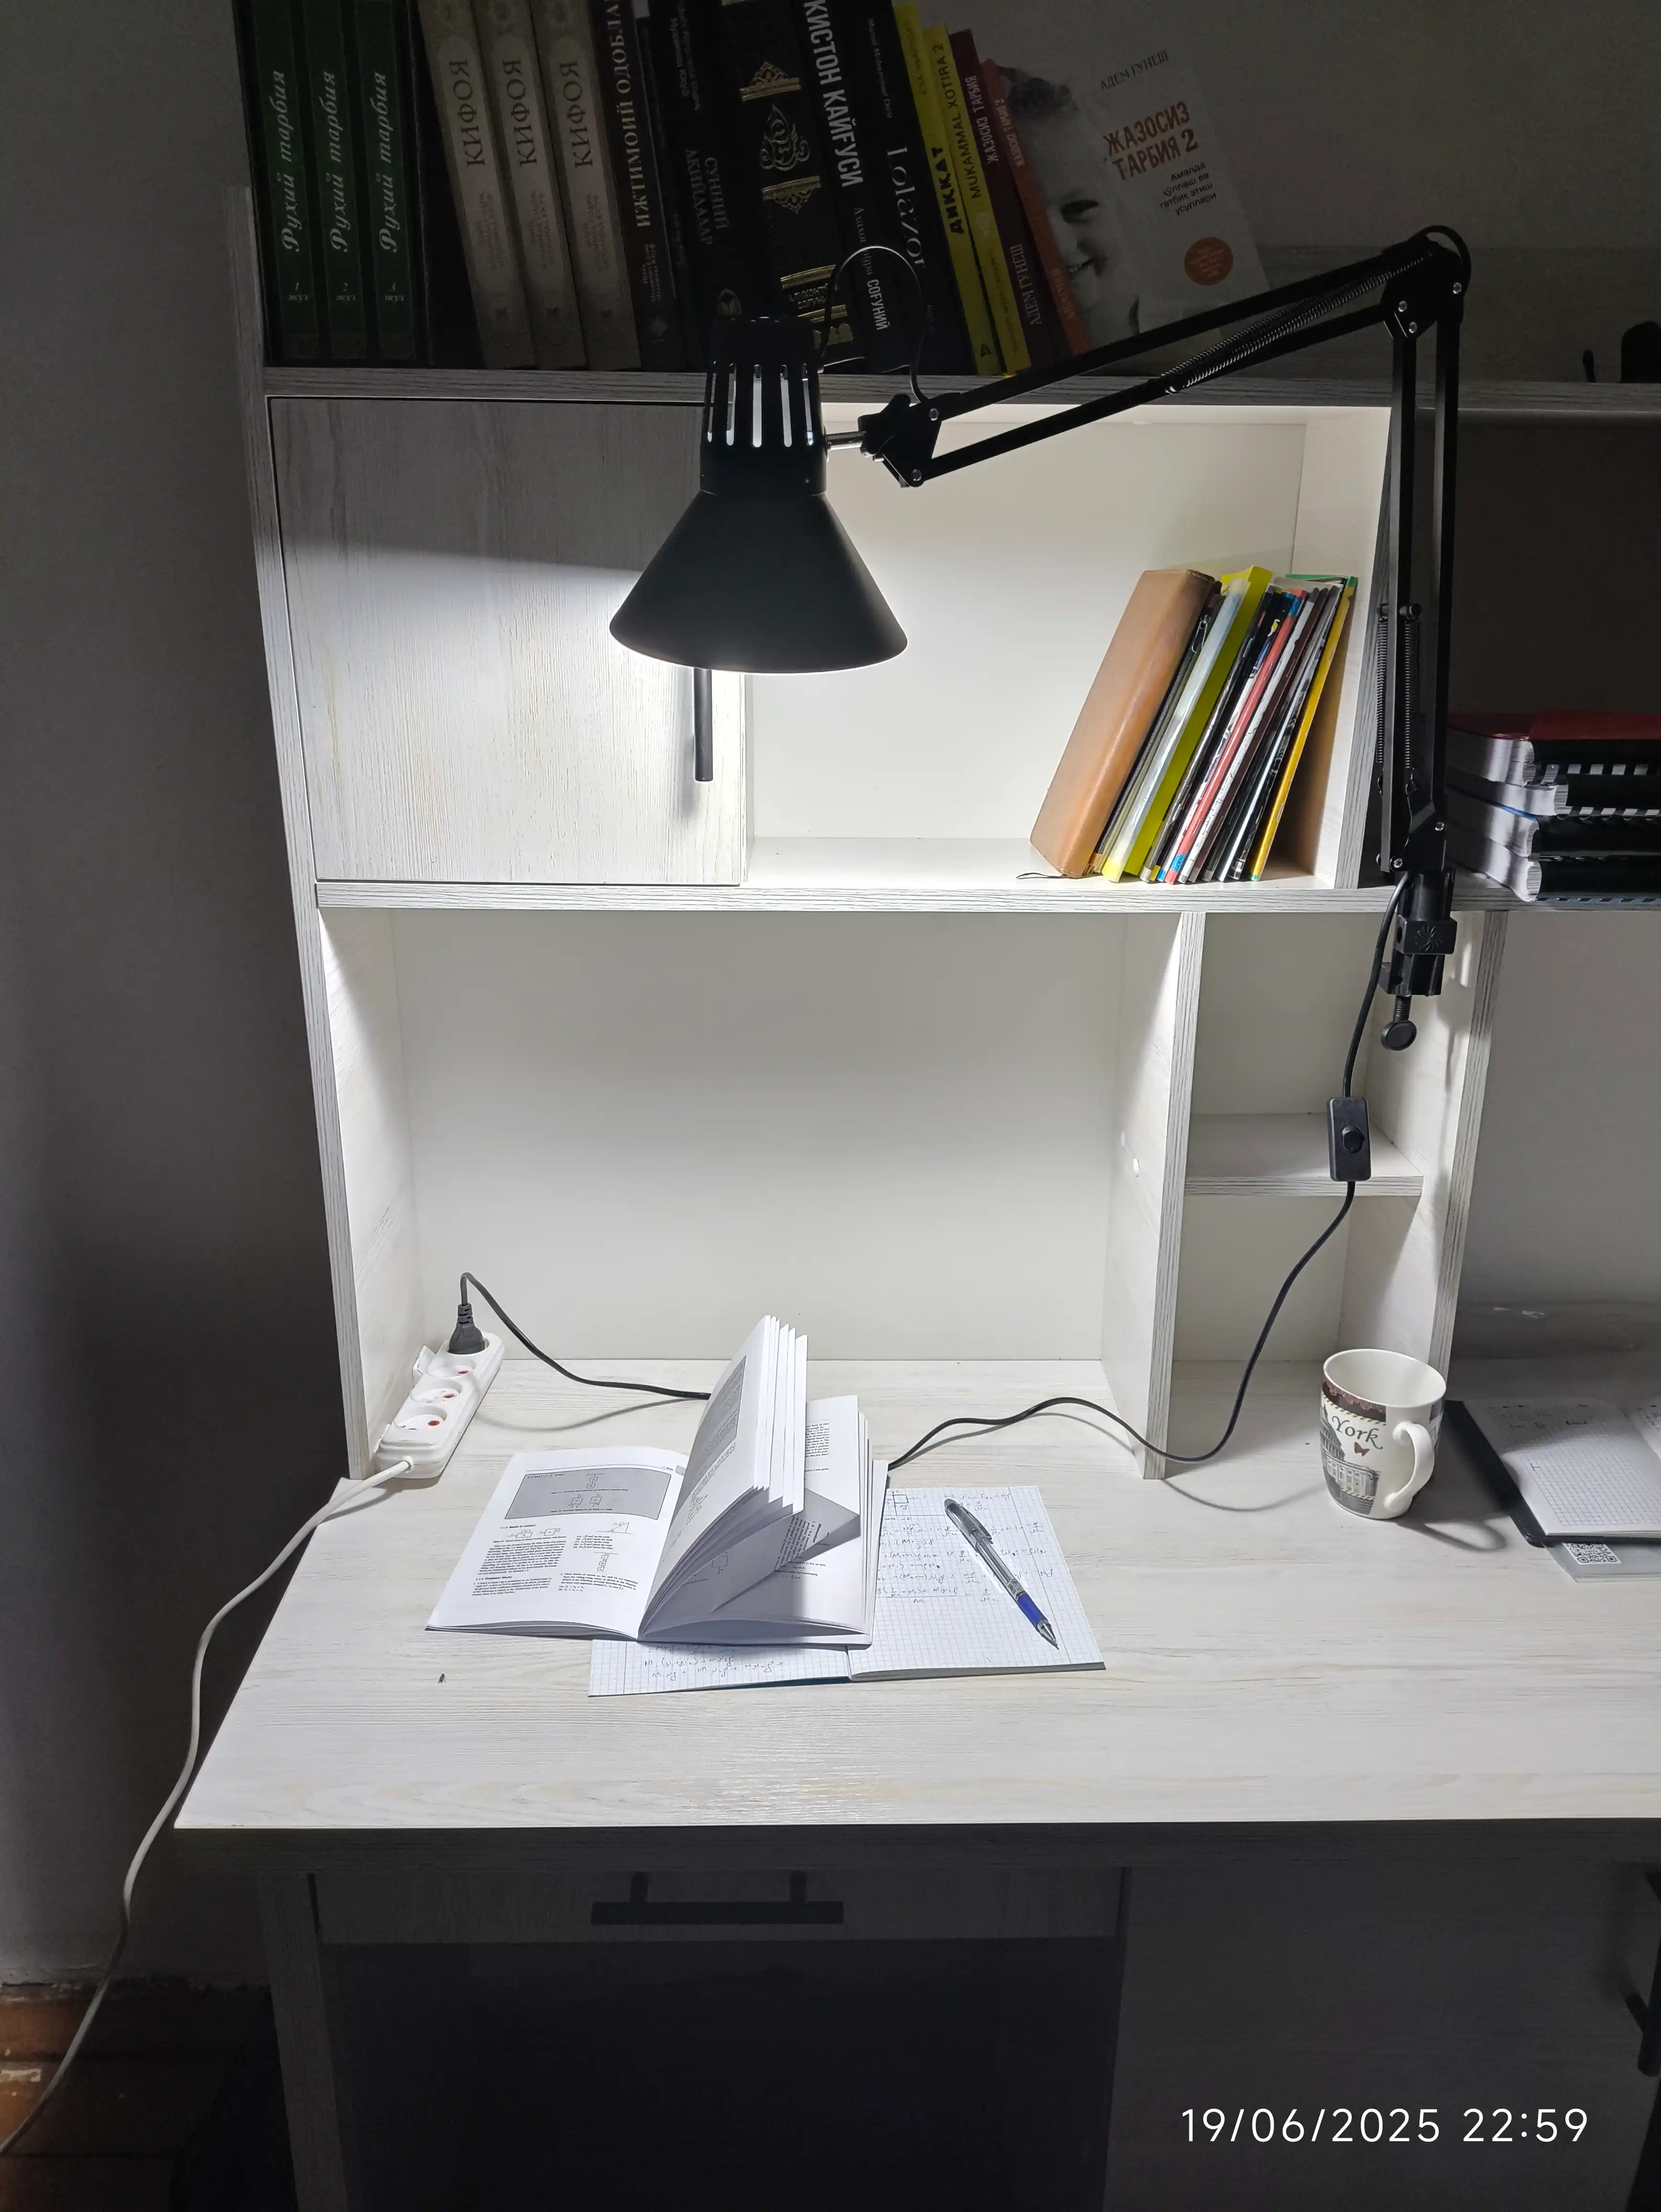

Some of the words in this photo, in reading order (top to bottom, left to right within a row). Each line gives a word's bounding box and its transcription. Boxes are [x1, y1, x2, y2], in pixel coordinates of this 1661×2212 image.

[603, 0, 631, 94] ОДОБЛА
[803, 0, 842, 85] КИСТОН
[932, 43, 944, 53] 2
[269, 69, 293, 163] тарбия
[319, 71, 343, 163] тарбия
[369, 72, 393, 164] тарбия
[449, 59, 485, 166] КИФОЯ
[503, 58, 538, 166] КИФОЯ
[559, 61, 593, 168] КИФОЯ
[937, 56, 958, 110] XOTIRA
[964, 75, 985, 113] ТАРБИЯ
[615, 100, 651, 227] ИЖТИМОИЙ
[951, 113, 981, 199] MUKAMMAL
[976, 116, 999, 164] ЖАЗОСИЗ
[1103, 101, 1190, 156] ЖАЗОСИЗ
[1112, 135, 1181, 180] ТАРБИЯ
[1181, 129, 1198, 152] 2
[705, 157, 731, 230] СУННИЙ
[1010, 244, 1032, 289] ГУНЕШ
[1022, 290, 1042, 324] АДЕМ
[1331, 1415, 1384, 1450] York
